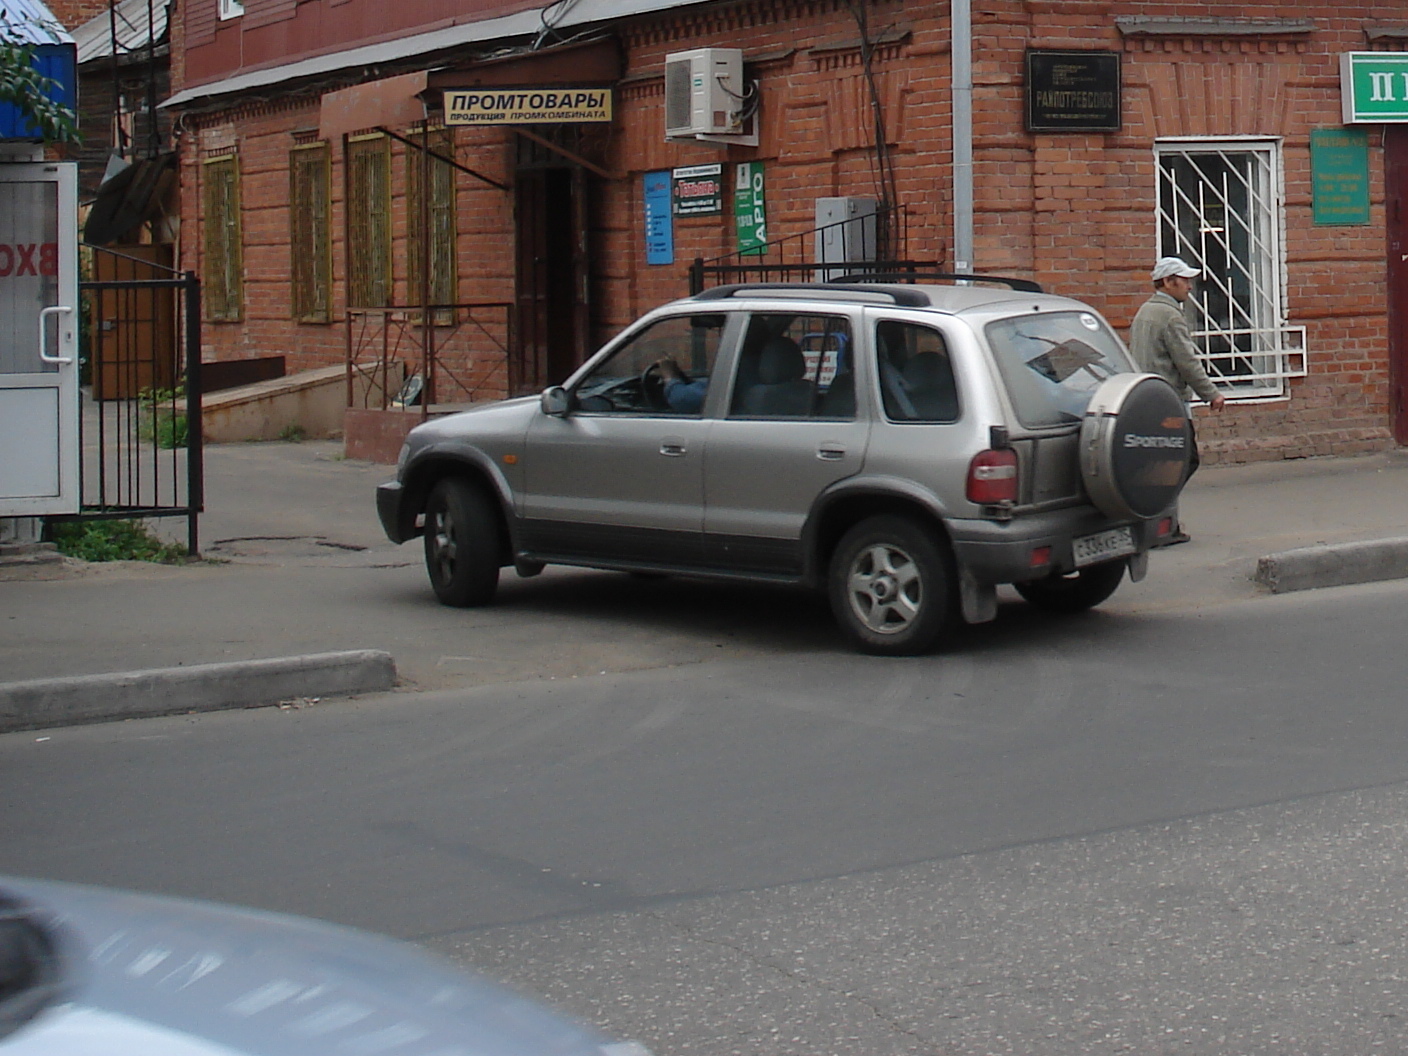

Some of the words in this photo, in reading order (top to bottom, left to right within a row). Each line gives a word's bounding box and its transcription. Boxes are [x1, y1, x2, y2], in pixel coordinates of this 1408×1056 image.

[451, 92, 605, 111] ПРОМТОВАРЫ
[1035, 90, 1113, 109] РАЙПОТРЕБСОЮЗ
[450, 112, 506, 122] ПРОДУКЦИЯ
[510, 110, 606, 121] ПРОМКОМБИНАТА
[753, 172, 766, 243] АРГО
